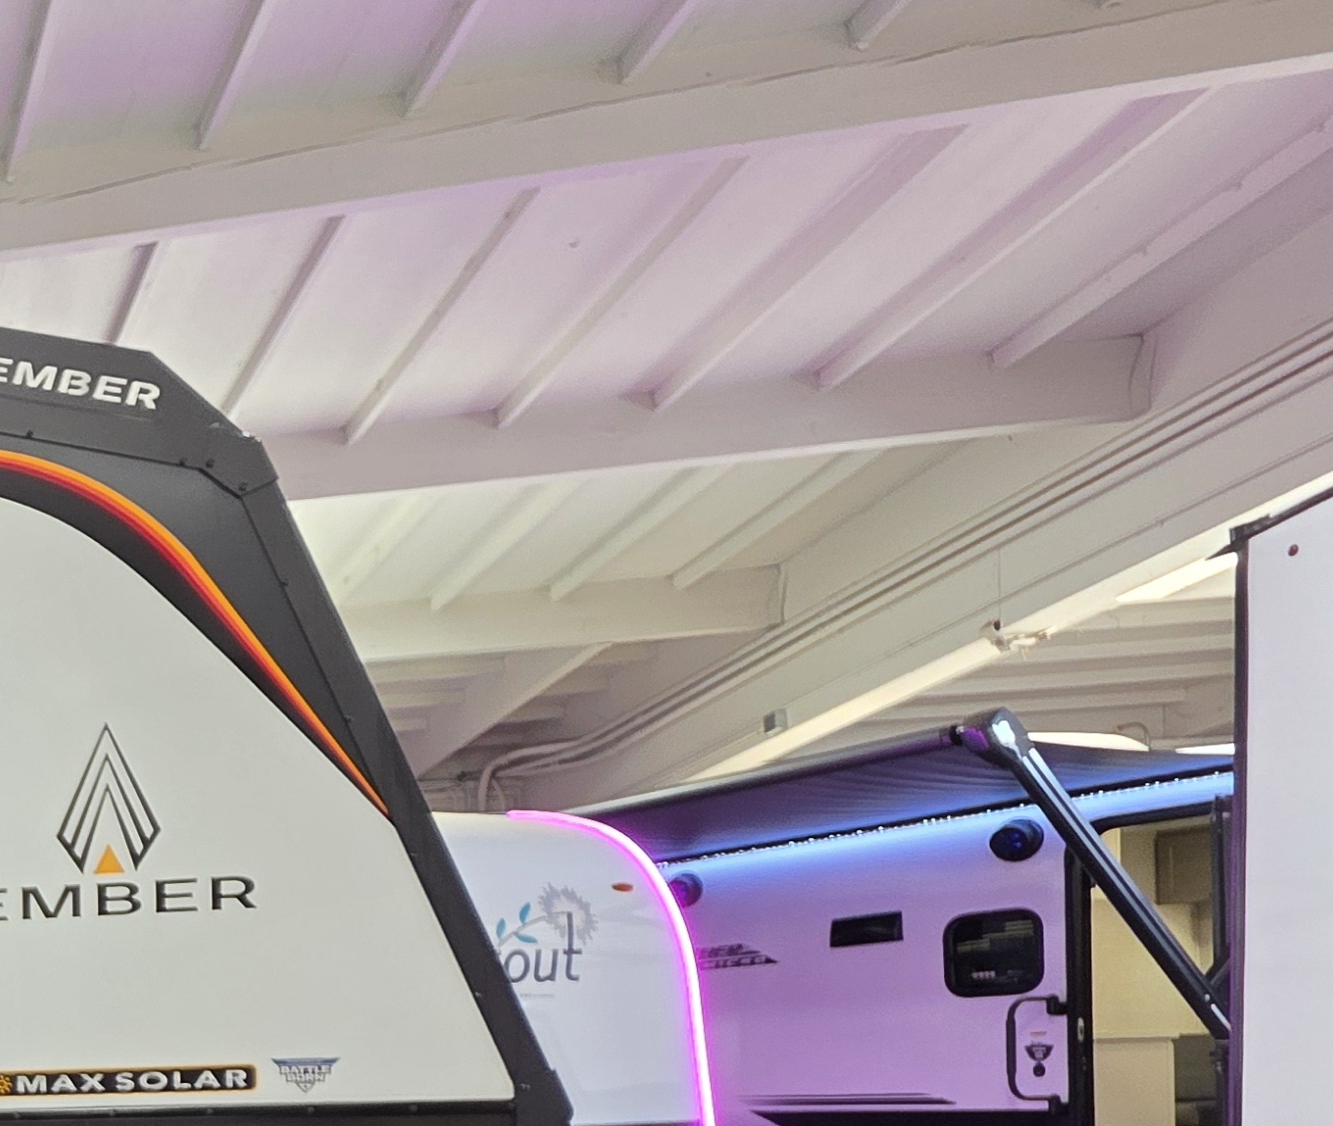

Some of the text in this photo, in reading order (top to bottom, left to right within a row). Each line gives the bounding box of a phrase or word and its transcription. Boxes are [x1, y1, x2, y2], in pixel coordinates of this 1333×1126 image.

[497, 911, 582, 983] out
[16, 1069, 247, 1094] MAX SOLAR
